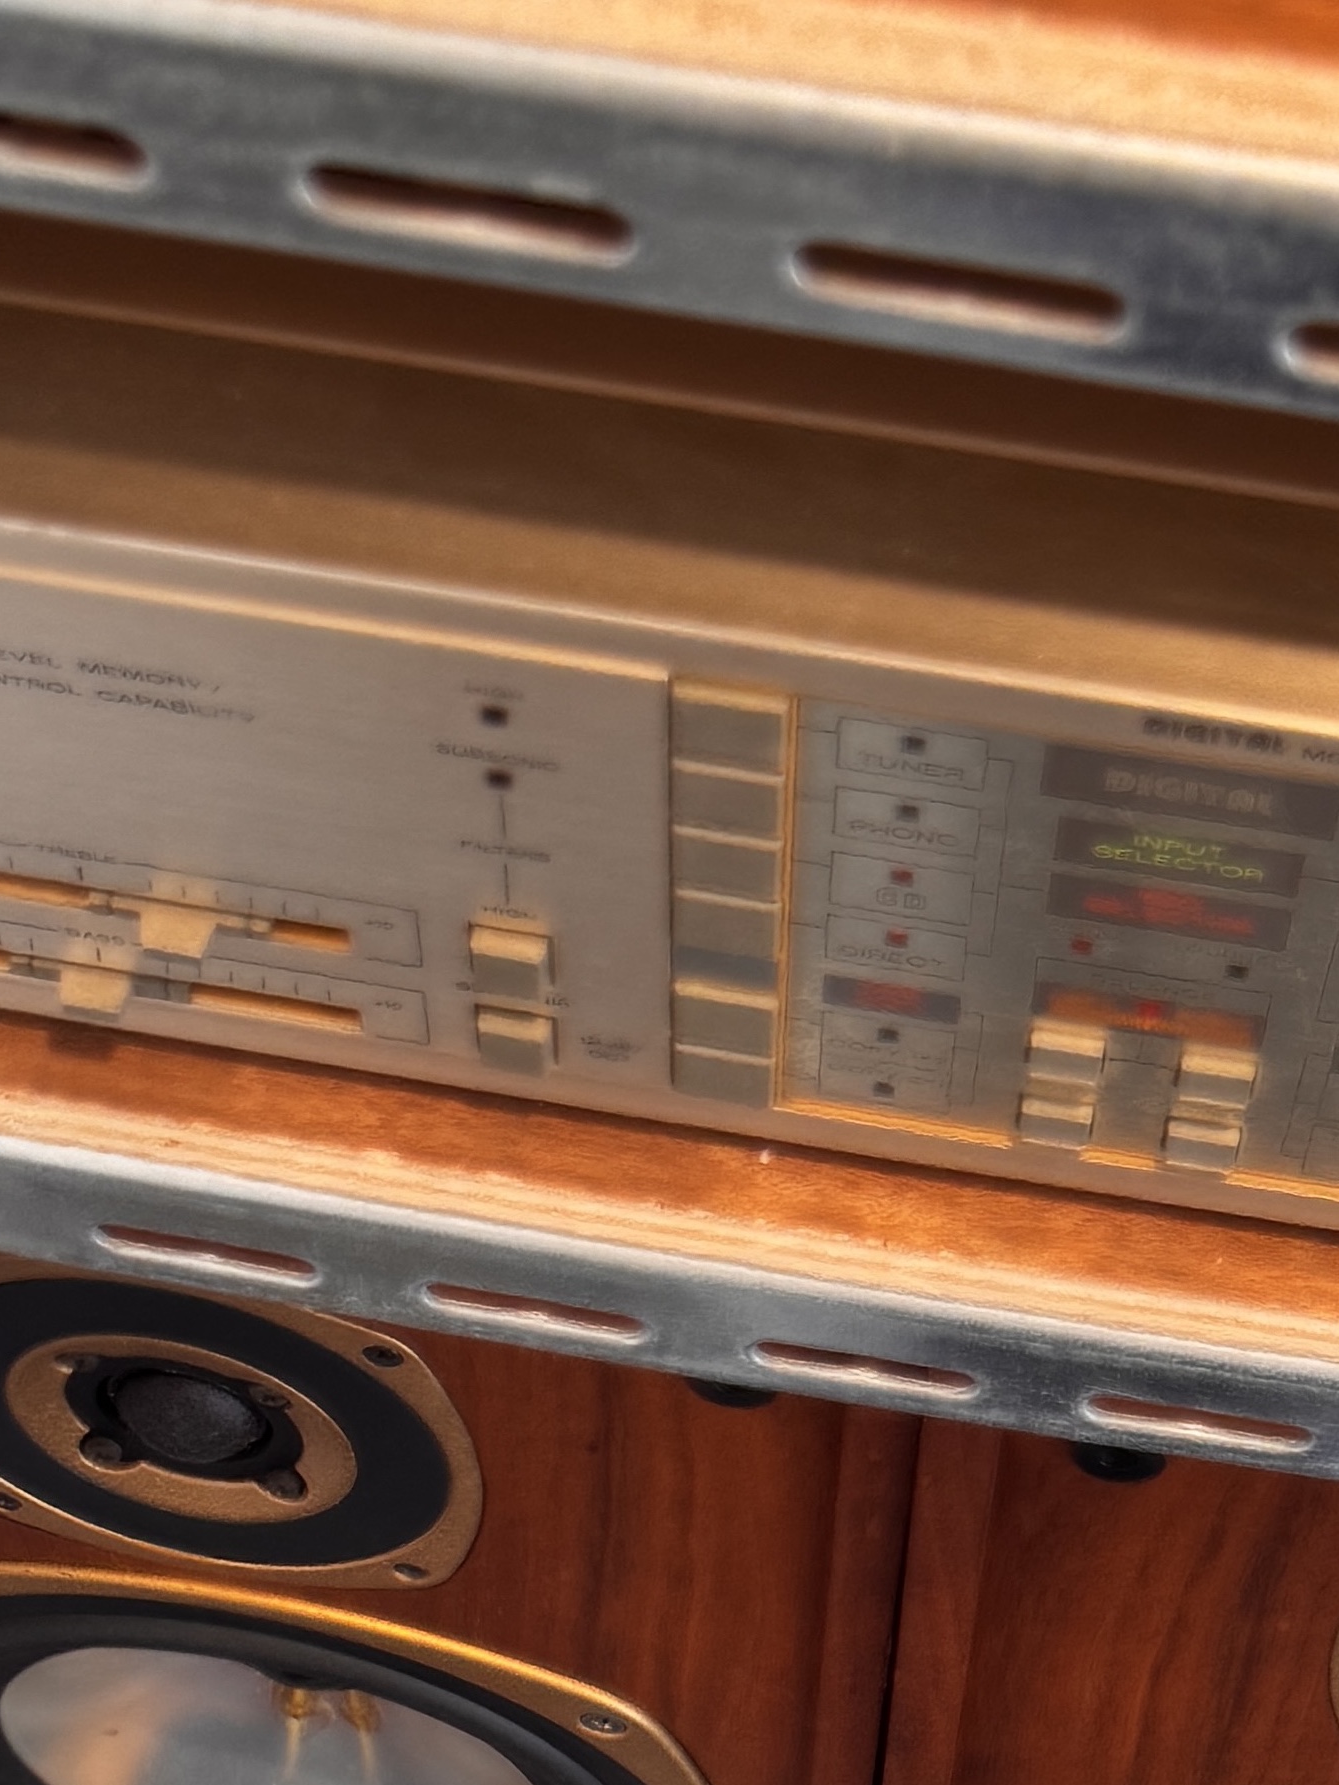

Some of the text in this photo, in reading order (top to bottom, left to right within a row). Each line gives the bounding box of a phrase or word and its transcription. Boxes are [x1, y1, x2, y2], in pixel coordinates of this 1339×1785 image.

[79, 659, 202, 690] MEMORY
[97, 689, 255, 723] CAPABILITY
[1142, 716, 1283, 751] DIGITAL
[858, 751, 964, 782] TUNER
[848, 820, 960, 848] PHONO
[1134, 835, 1223, 858] INPUT
[1093, 845, 1264, 881] SELECTOR
[837, 943, 945, 970] DIRECT
